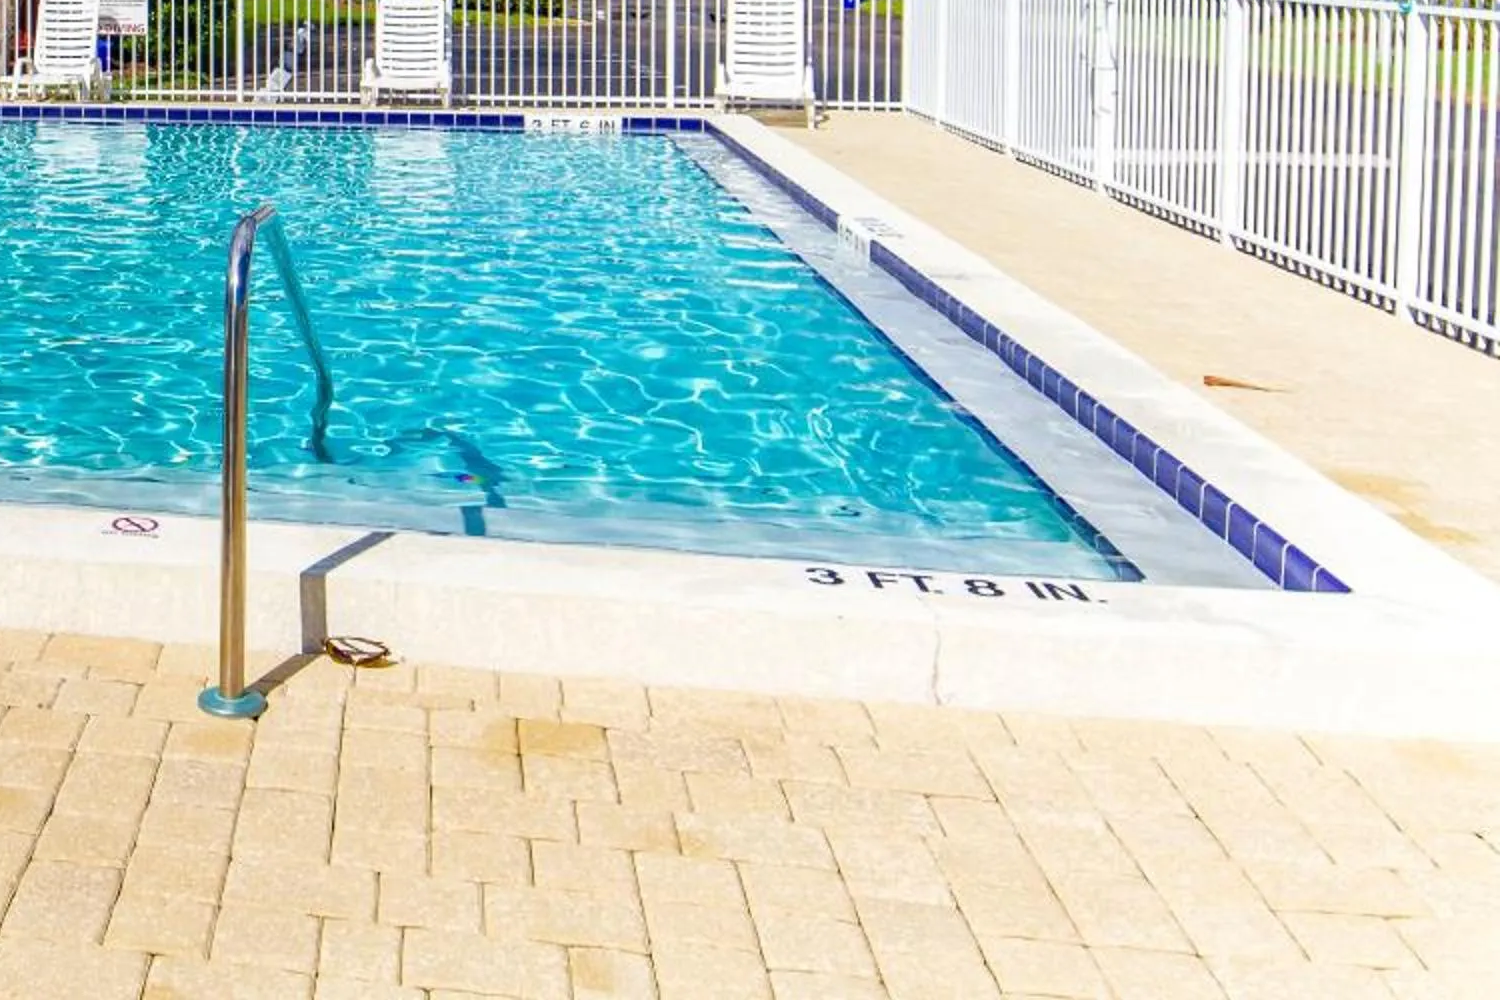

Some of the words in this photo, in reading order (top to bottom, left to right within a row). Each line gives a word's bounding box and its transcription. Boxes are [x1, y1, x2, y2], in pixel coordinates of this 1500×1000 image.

[805, 567, 845, 586] 3
[866, 570, 944, 595] FT.
[964, 579, 1006, 598] 8
[1025, 581, 1108, 604] IN.
